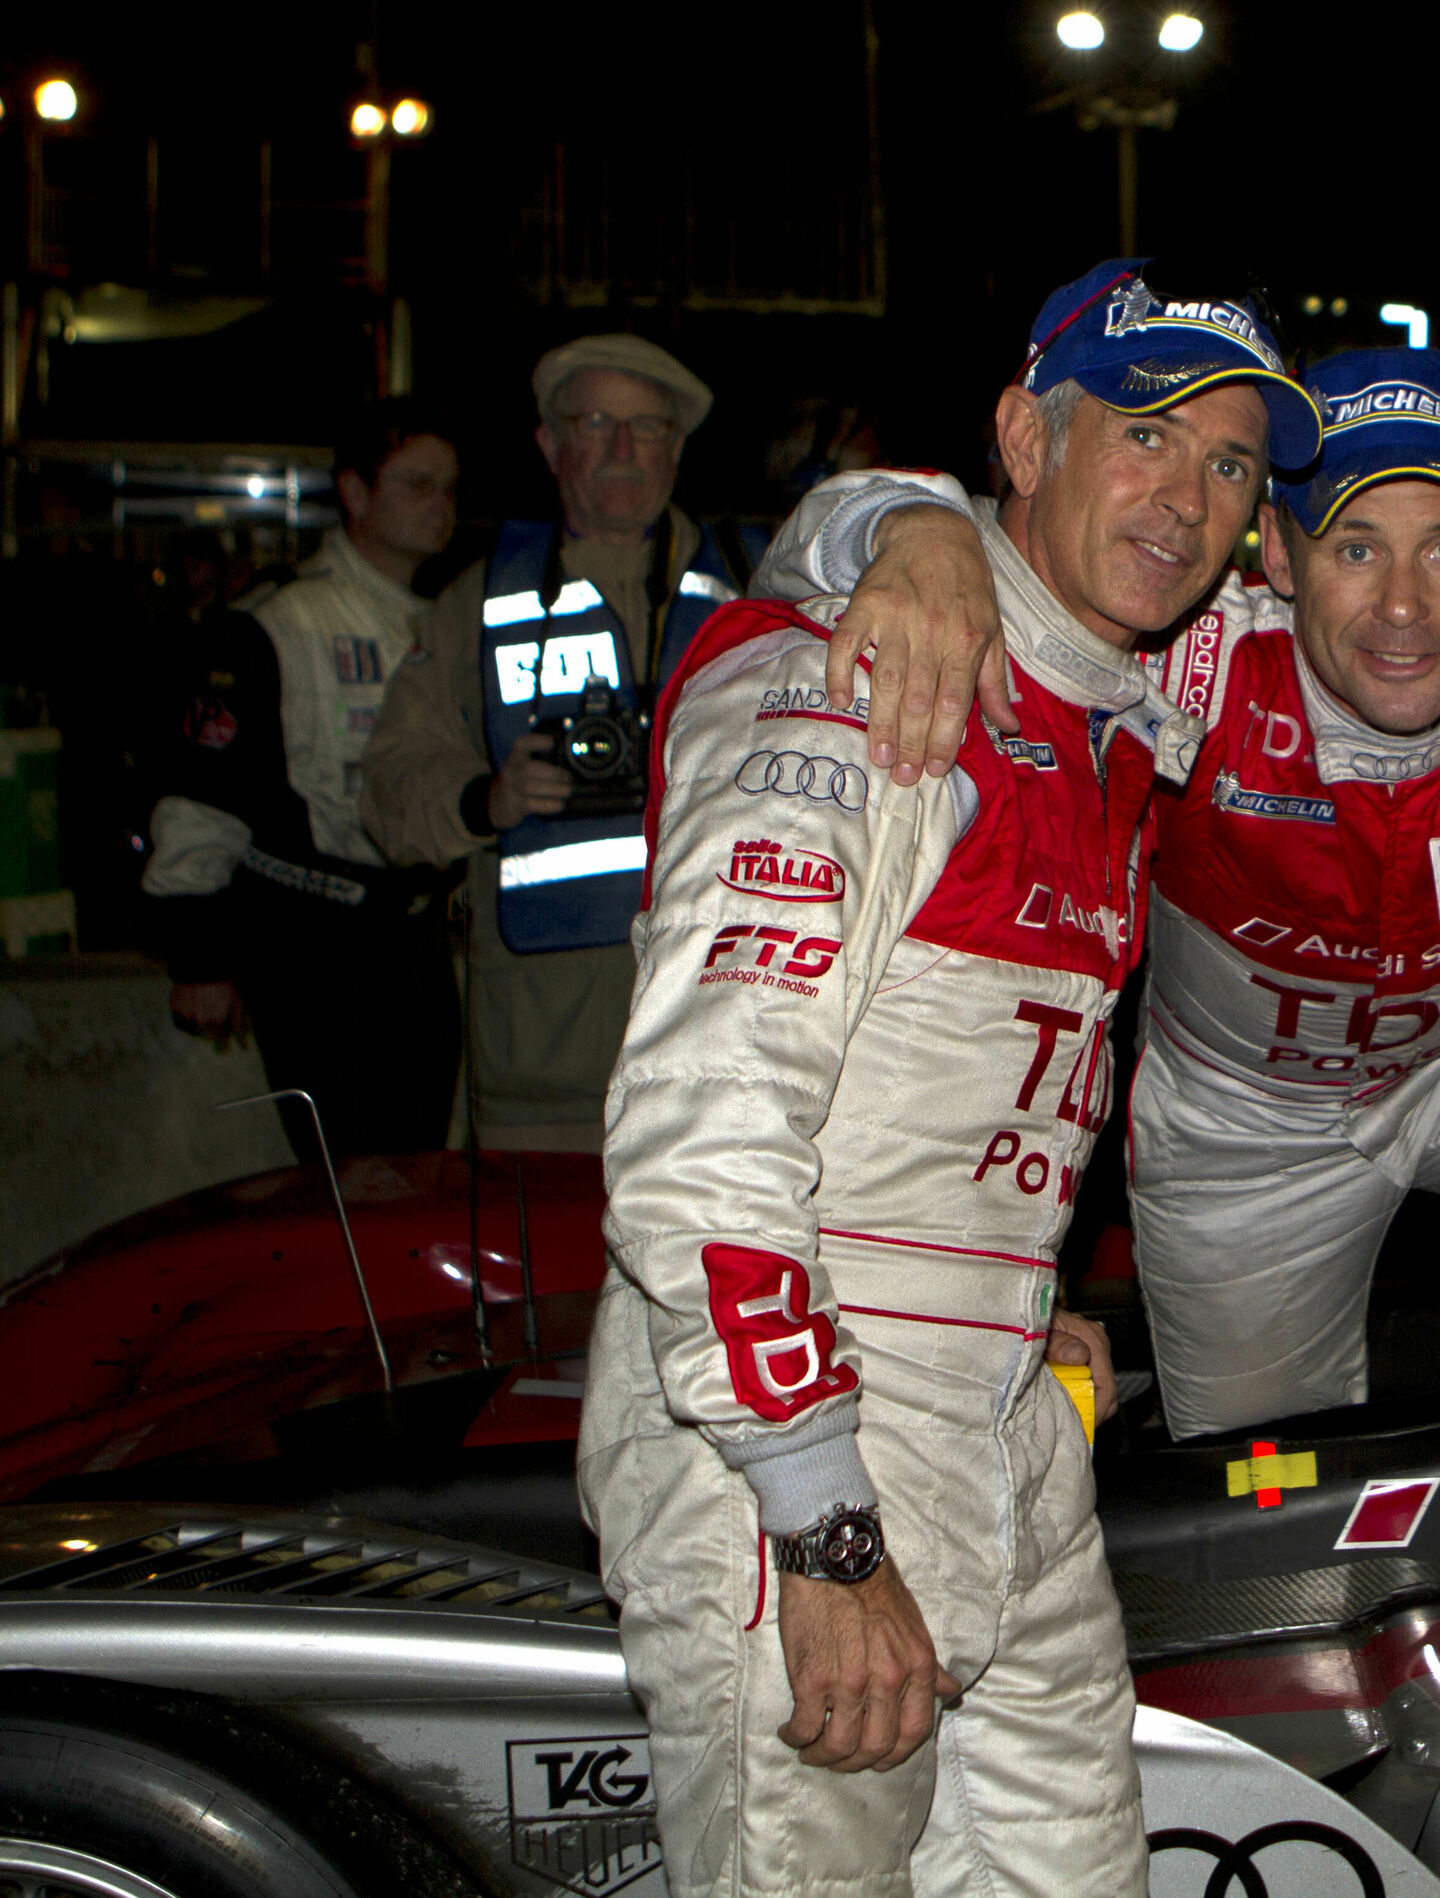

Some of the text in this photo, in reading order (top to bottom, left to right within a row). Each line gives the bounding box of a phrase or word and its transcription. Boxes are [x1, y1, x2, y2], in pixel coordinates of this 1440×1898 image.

[760, 687, 870, 719] SANDE
[1236, 795, 1335, 818] MICHELIN
[729, 855, 835, 892] ITALIA
[704, 925, 843, 978] FTS
[1295, 934, 1405, 978] Audi
[698, 967, 820, 998] technology in motion
[535, 1744, 649, 1809] TAG
